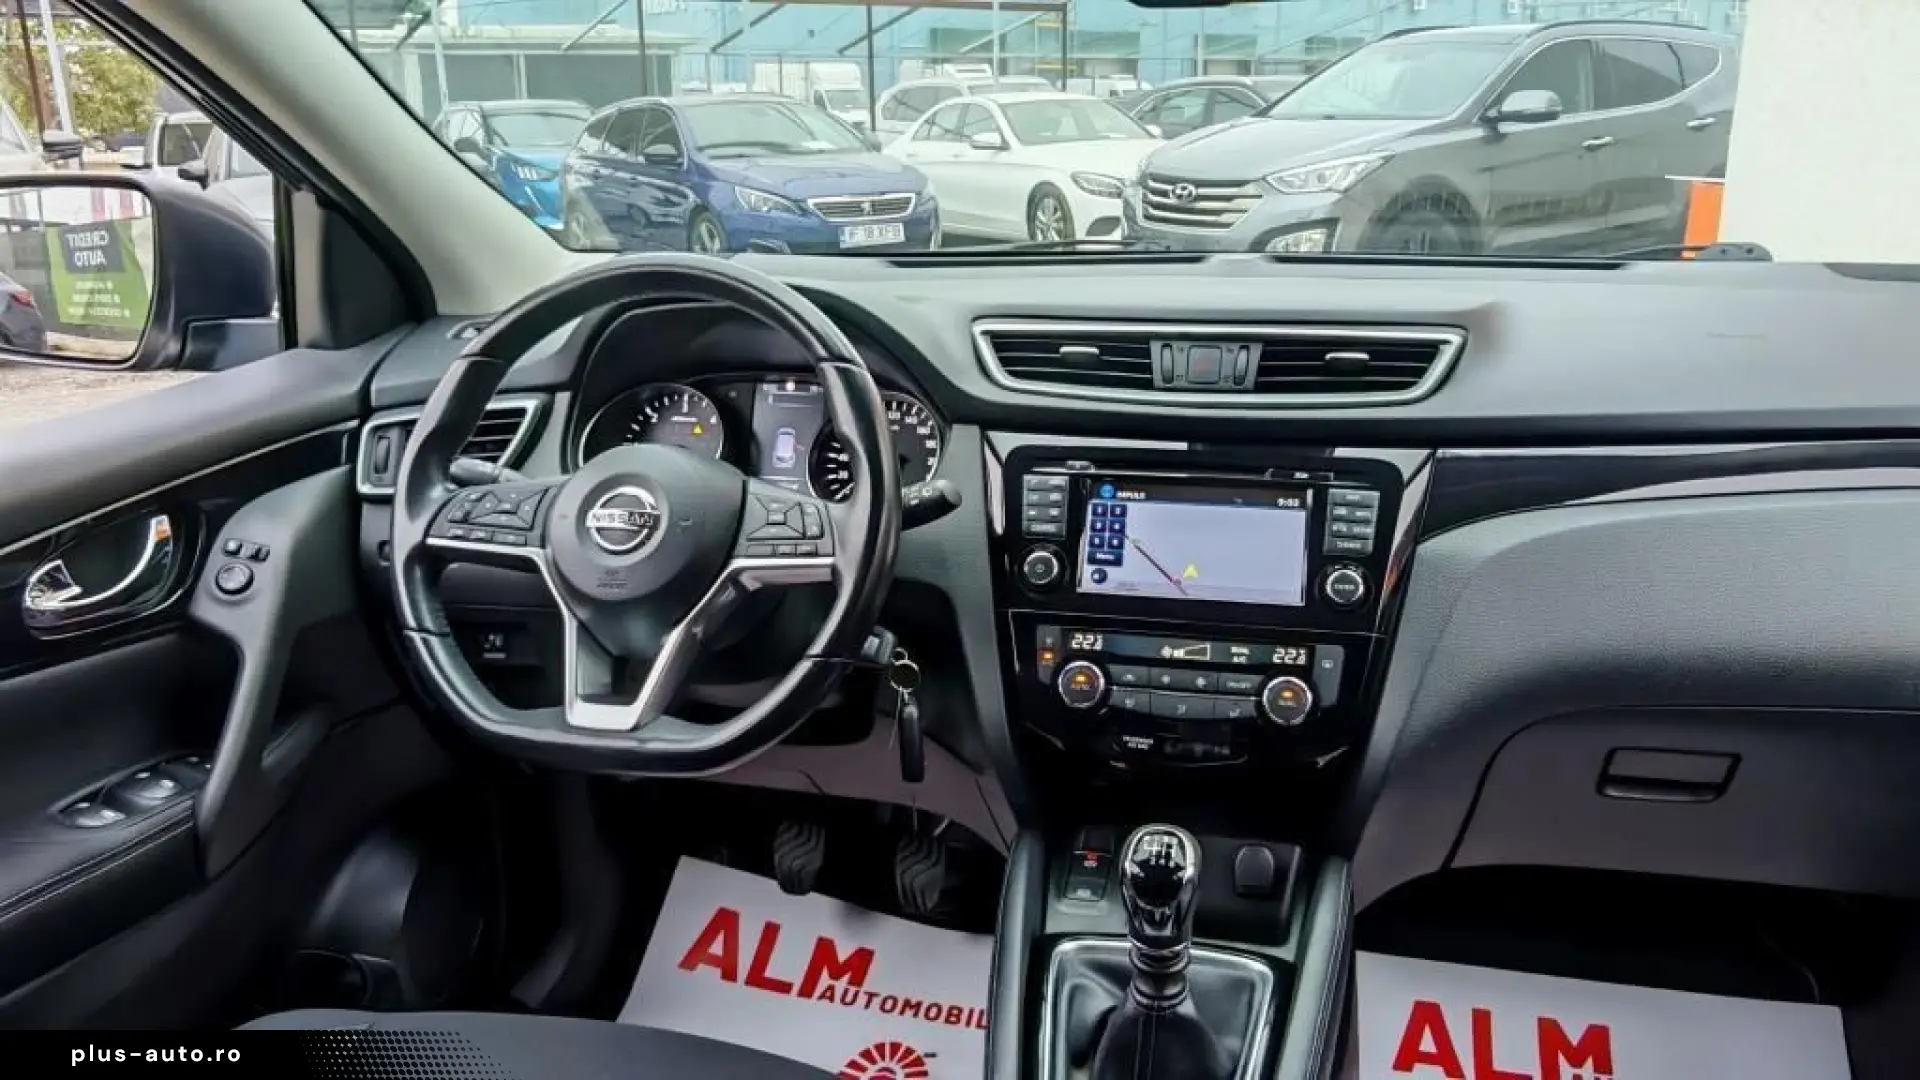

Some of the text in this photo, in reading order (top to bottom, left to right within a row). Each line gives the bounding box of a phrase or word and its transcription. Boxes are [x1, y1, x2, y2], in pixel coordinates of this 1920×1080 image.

[591, 511, 654, 526] NISSAN
[677, 906, 875, 999] ALM
[817, 984, 990, 1030] AUTOMOBIL
[1392, 1000, 1613, 1080] ALM
